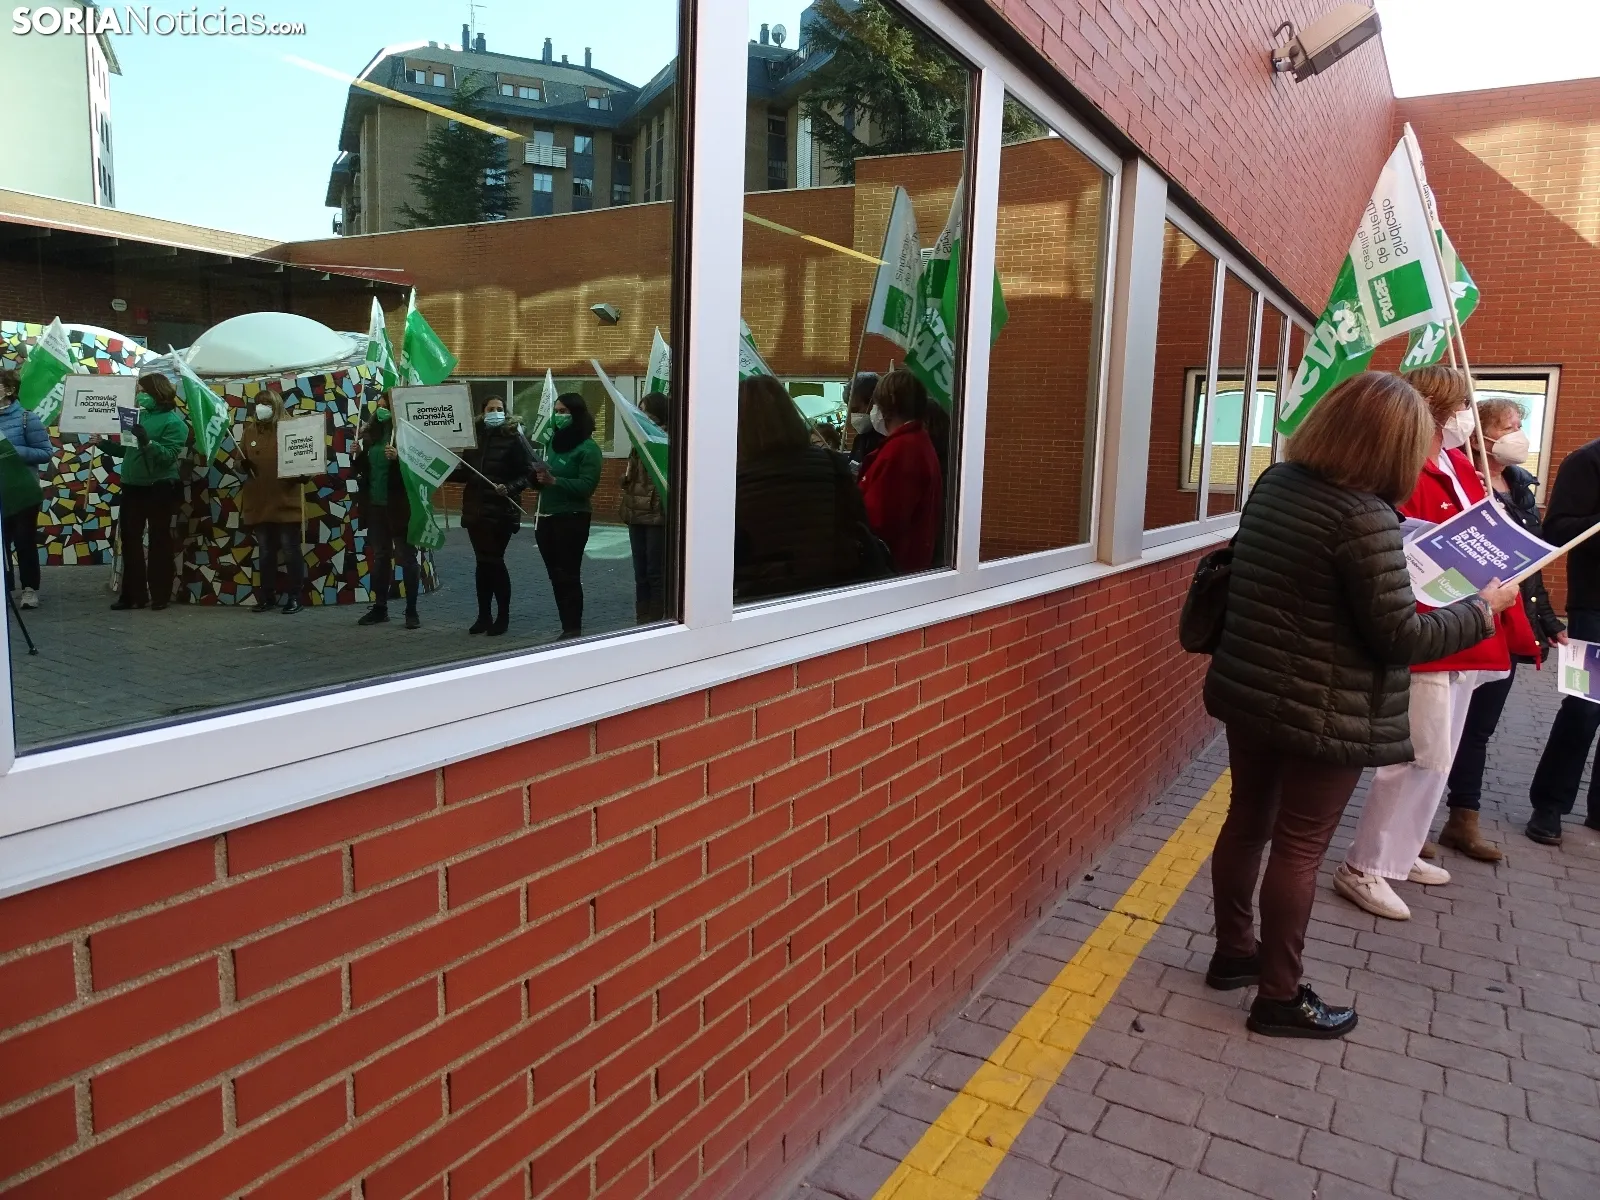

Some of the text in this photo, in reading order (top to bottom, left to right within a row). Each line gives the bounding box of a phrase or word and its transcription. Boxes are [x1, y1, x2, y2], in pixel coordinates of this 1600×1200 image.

[1451, 534, 1488, 566] Primaria
[1458, 530, 1508, 570] la Atención
[1467, 526, 1510, 561] Salvemos
